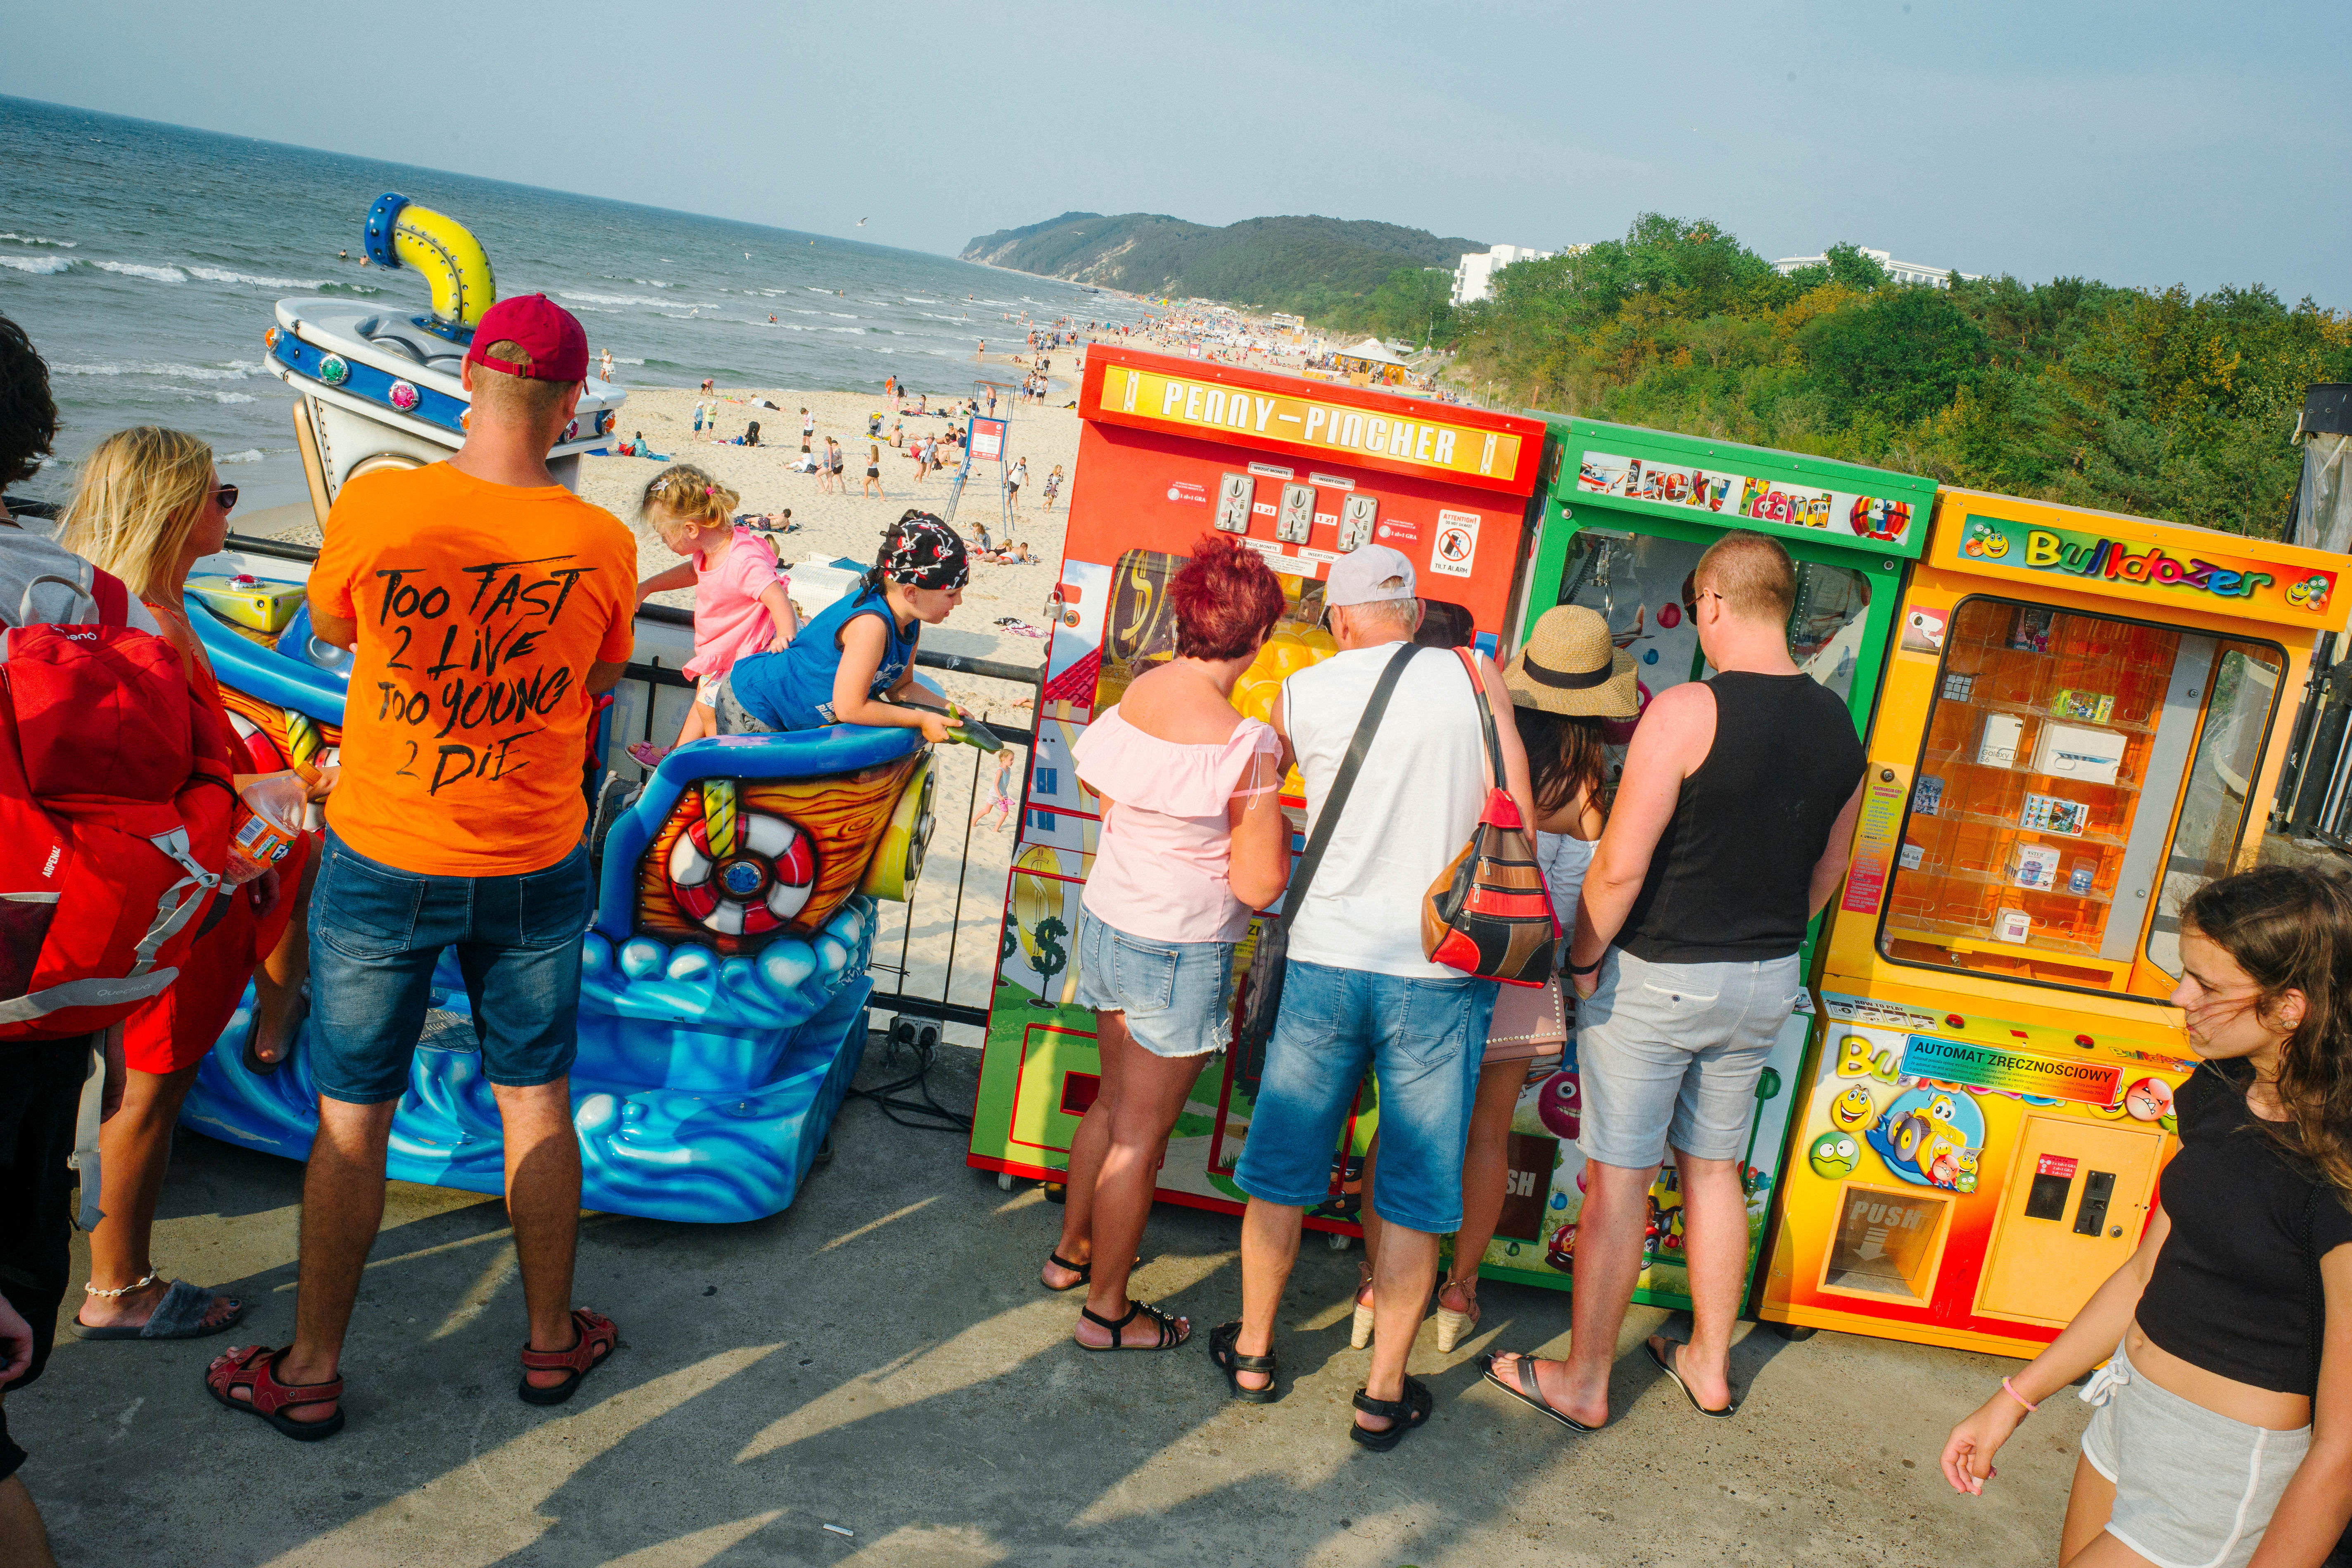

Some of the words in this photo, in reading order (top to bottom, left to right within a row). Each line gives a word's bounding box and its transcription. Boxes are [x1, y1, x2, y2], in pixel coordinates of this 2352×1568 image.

[1625, 459, 1732, 512] Lucky
[1739, 476, 1832, 528] Hand
[1443, 513, 1477, 524] ATTENTION!
[2024, 530, 2273, 597] Bulldozer
[376, 568, 450, 627] TOO
[462, 554, 599, 626] FAST
[386, 625, 413, 670] 2
[377, 681, 430, 726] TOO
[396, 740, 421, 780] 2
[1982, 749, 2009, 760] Galaxy
[42, 845, 61, 878] ARPENAZ
[1914, 1042, 1985, 1063] AUTOMAT
[1987, 1054, 2112, 1083] ZRĘCZNOŚCIOWY
[2108, 1046, 2200, 1068] Bulldoze
[1506, 1169, 1537, 1197] SH
[1850, 1201, 1923, 1230] PUSH
